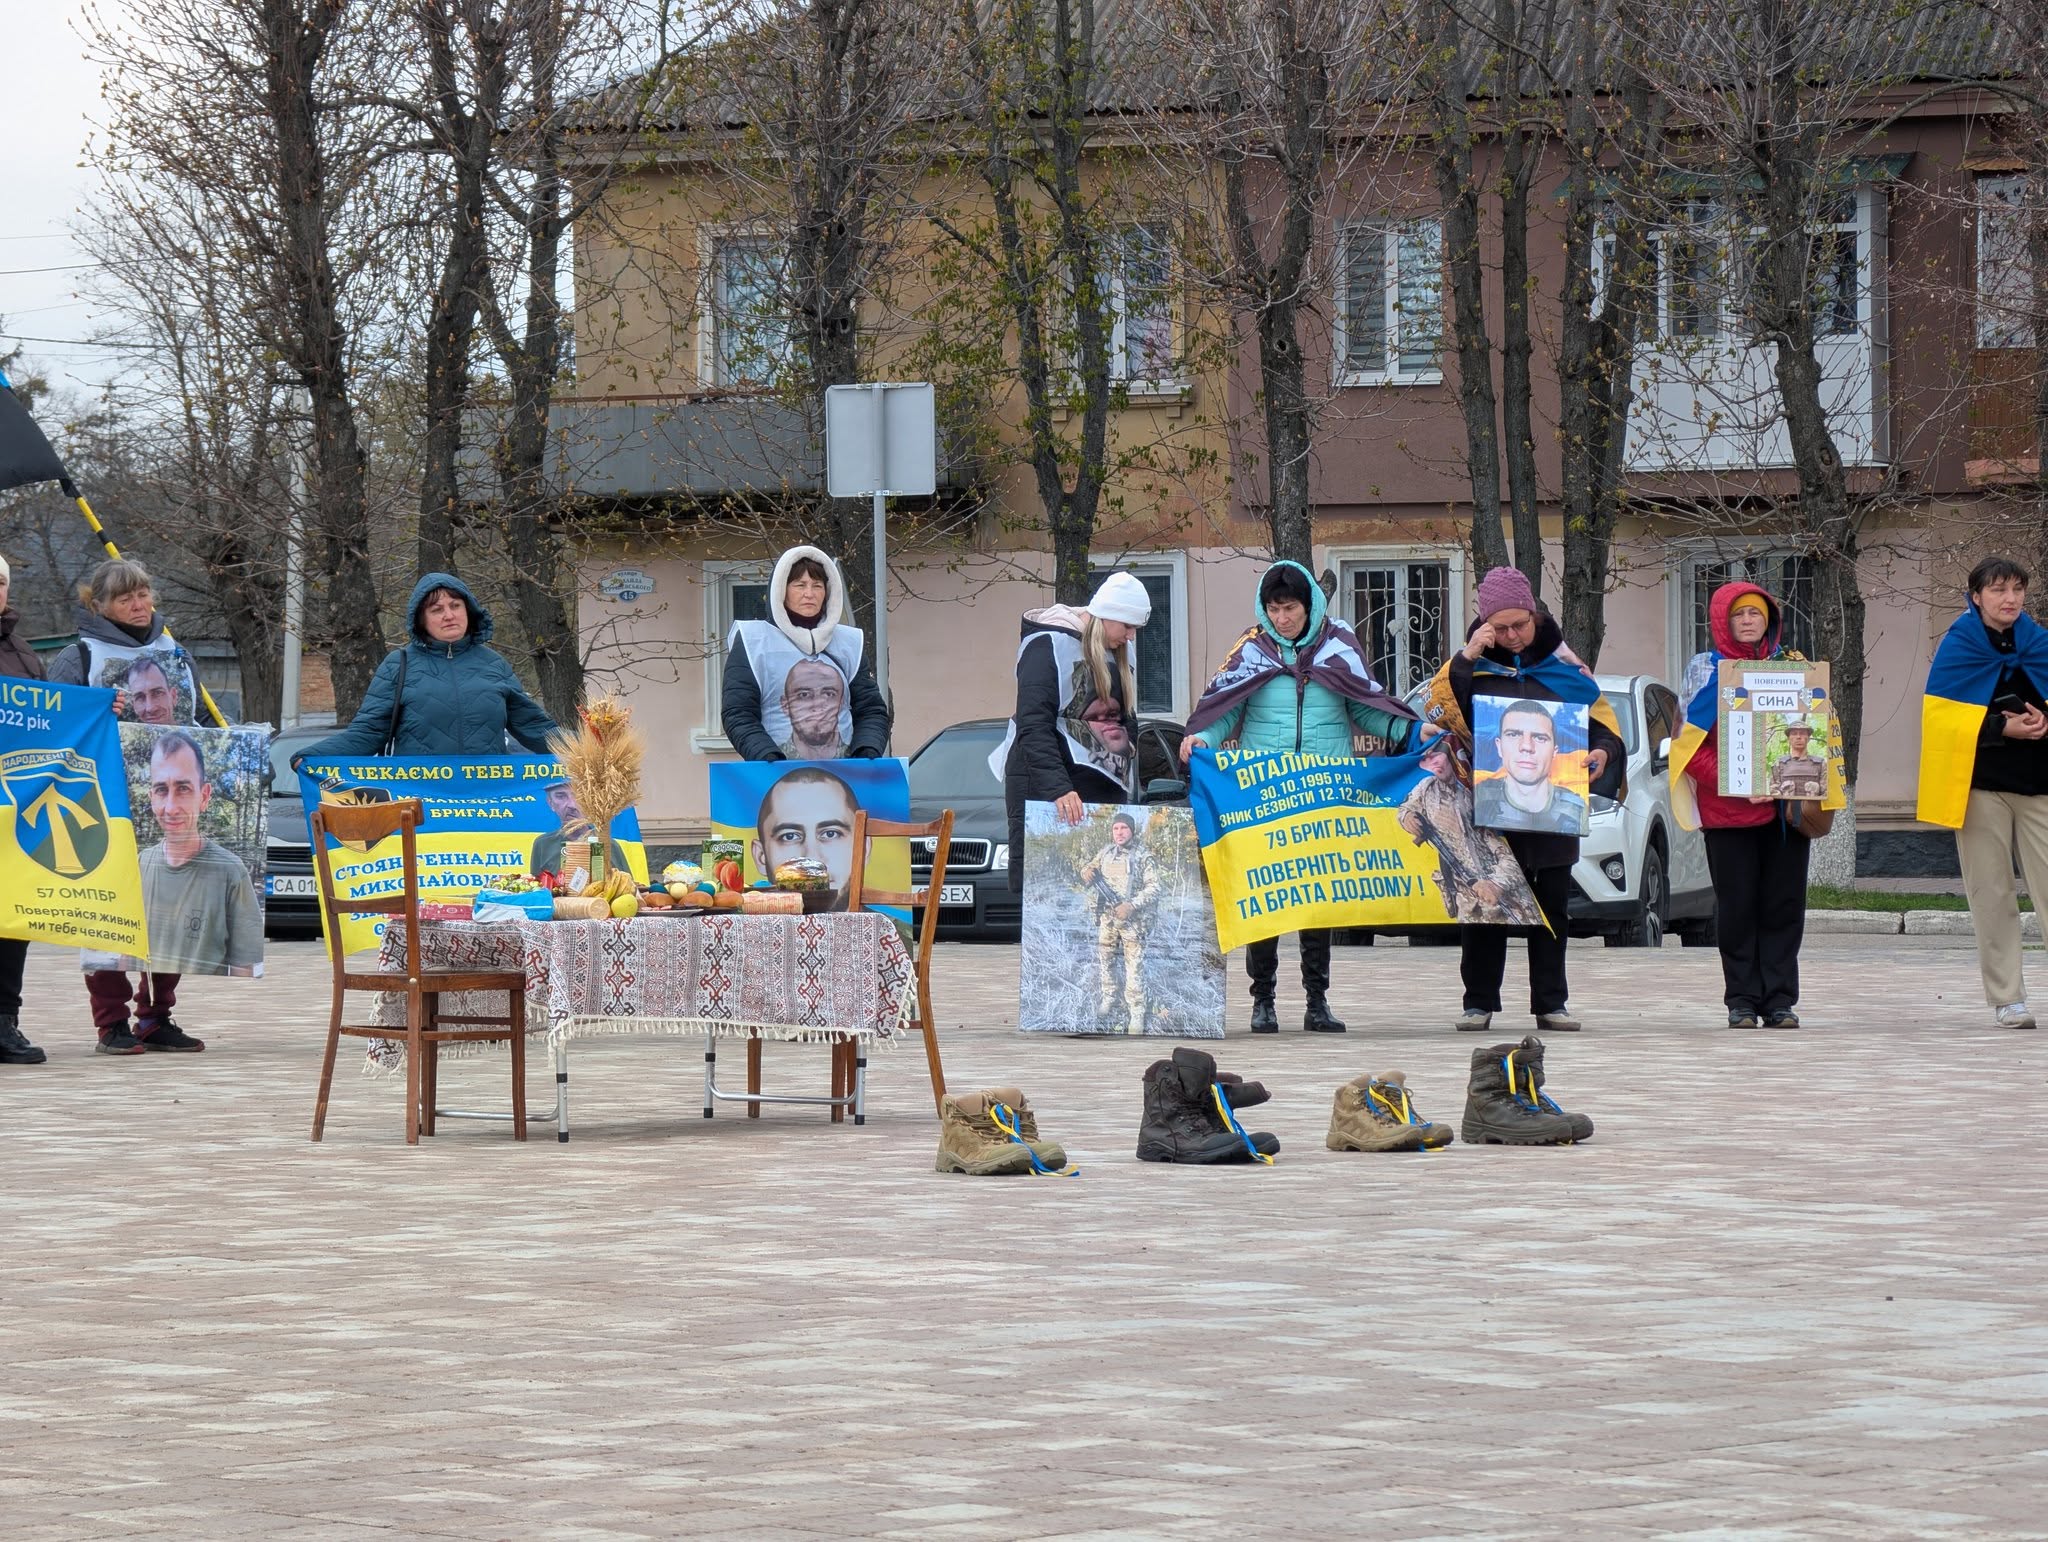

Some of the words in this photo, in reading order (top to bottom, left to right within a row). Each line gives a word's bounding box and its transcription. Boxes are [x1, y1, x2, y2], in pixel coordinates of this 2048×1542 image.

[621, 592, 635, 600] 45
[0, 683, 62, 712] ІСТИ
[1757, 696, 1794, 707] СИНА
[27, 714, 51, 731] рік
[3, 752, 65, 769] НАРОДЖЕНІ
[349, 766, 454, 780] ЧЕКАЄМО
[461, 765, 514, 779] ТЕБЕ
[522, 764, 570, 780] ДОД
[430, 808, 514, 819] БРИГАДА
[1219, 808, 1254, 828] ЗНИК
[1255, 791, 1316, 819] БЕЗВІСТИ
[1264, 829, 1288, 849] 79
[1291, 816, 1371, 844] БРИГАДА
[334, 857, 404, 881] СТОЯН
[1246, 851, 1350, 890] ПОВЕРНІТЬ
[1353, 848, 1404, 872] СИНА
[37, 888, 54, 898] 57
[59, 887, 117, 902] ОМПБР
[274, 879, 294, 892] CA
[350, 872, 503, 899] МИКОЛАЙОВИ
[1236, 895, 1263, 920] ТА
[1264, 882, 1327, 913] БРАТА
[1330, 875, 1412, 903] ДОДОМУ
[15, 904, 97, 920] Повертайся
[99, 912, 141, 930] живим!
[28, 921, 45, 931] ми
[48, 921, 78, 935] тебе
[80, 927, 136, 945] чекаємо!
